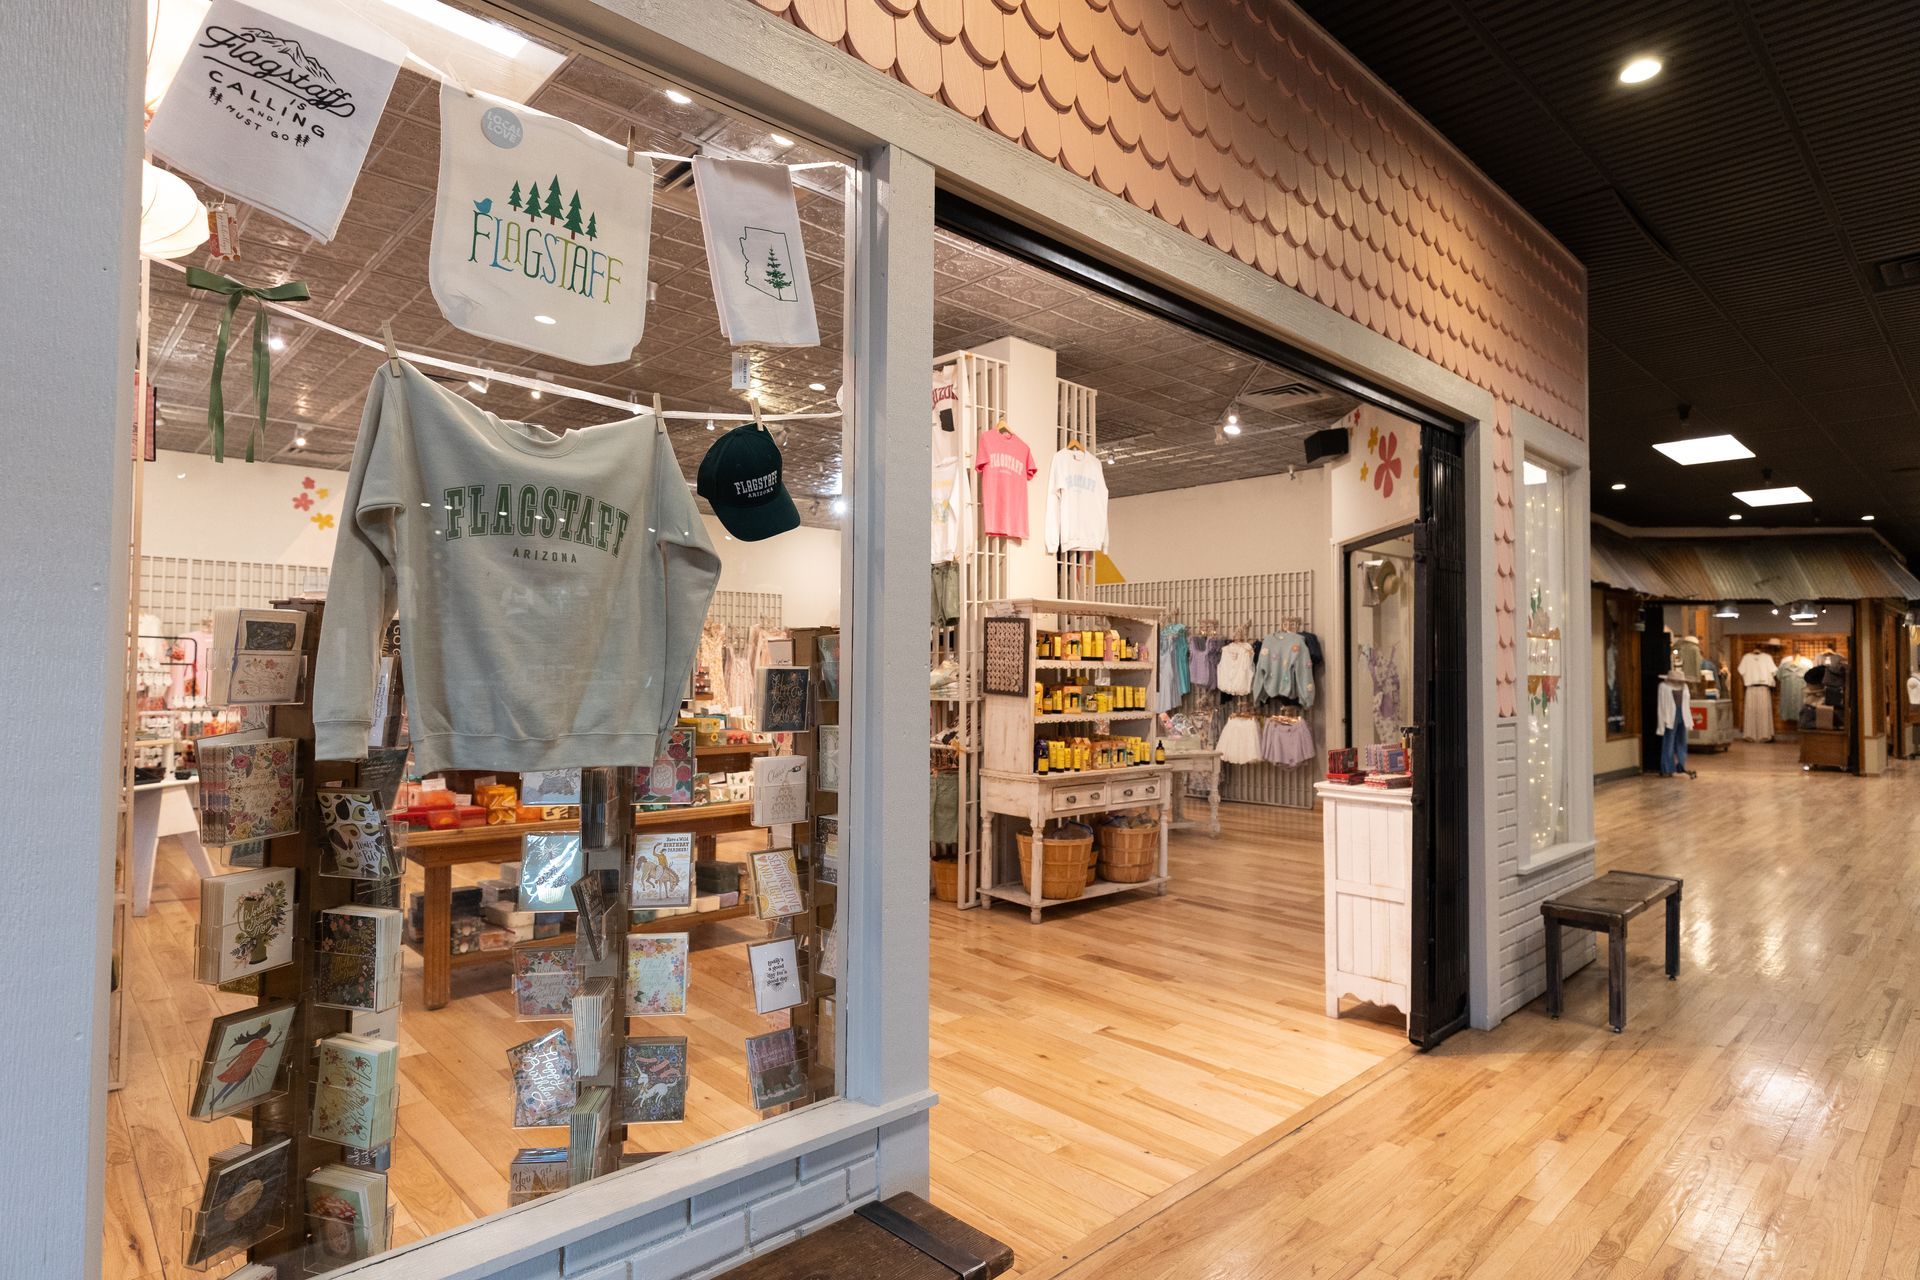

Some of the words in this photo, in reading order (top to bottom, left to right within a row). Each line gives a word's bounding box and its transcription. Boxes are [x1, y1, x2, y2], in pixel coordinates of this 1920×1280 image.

[198, 25, 356, 118] Flagstaff
[208, 70, 325, 138] CALLING
[247, 106, 273, 123] AND
[289, 98, 307, 111] IS
[226, 104, 262, 131] MUST
[270, 130, 290, 141] GO
[486, 110, 521, 138] LOCAL
[486, 121, 518, 145] LOVE
[467, 209, 624, 305] FLAGSTAFF
[733, 469, 779, 496] FLAGSTAFF
[747, 486, 775, 499] ARIZONA
[443, 484, 631, 559] FLAGSTAFF
[512, 546, 578, 564] ARIZONA
[766, 880, 786, 904] LIGHT
[767, 854, 792, 889] SENDING
[783, 887, 801, 910] LOVE
[522, 1054, 556, 1108] Birthday
[538, 1045, 566, 1091] Happy
[512, 1171, 532, 1192] You
